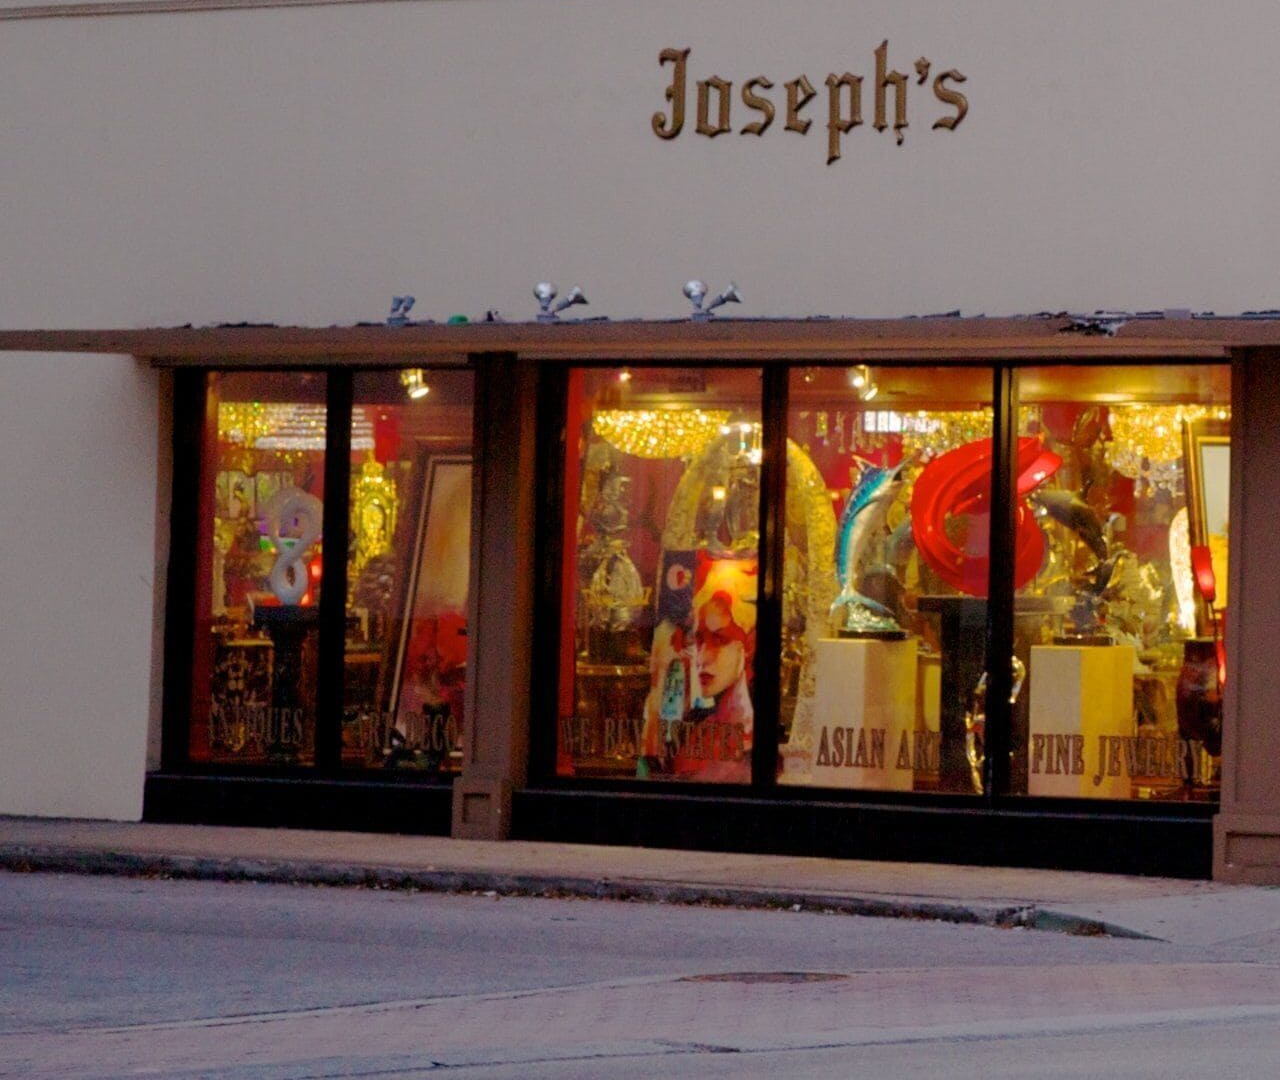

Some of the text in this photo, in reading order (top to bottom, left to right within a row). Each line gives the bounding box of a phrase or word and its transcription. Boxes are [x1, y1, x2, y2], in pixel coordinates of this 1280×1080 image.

[652, 39, 969, 166] Joseph's
[405, 711, 459, 751] DECO
[816, 726, 886, 769] ASIAN
[1031, 733, 1203, 786] FINE JEWELRY
